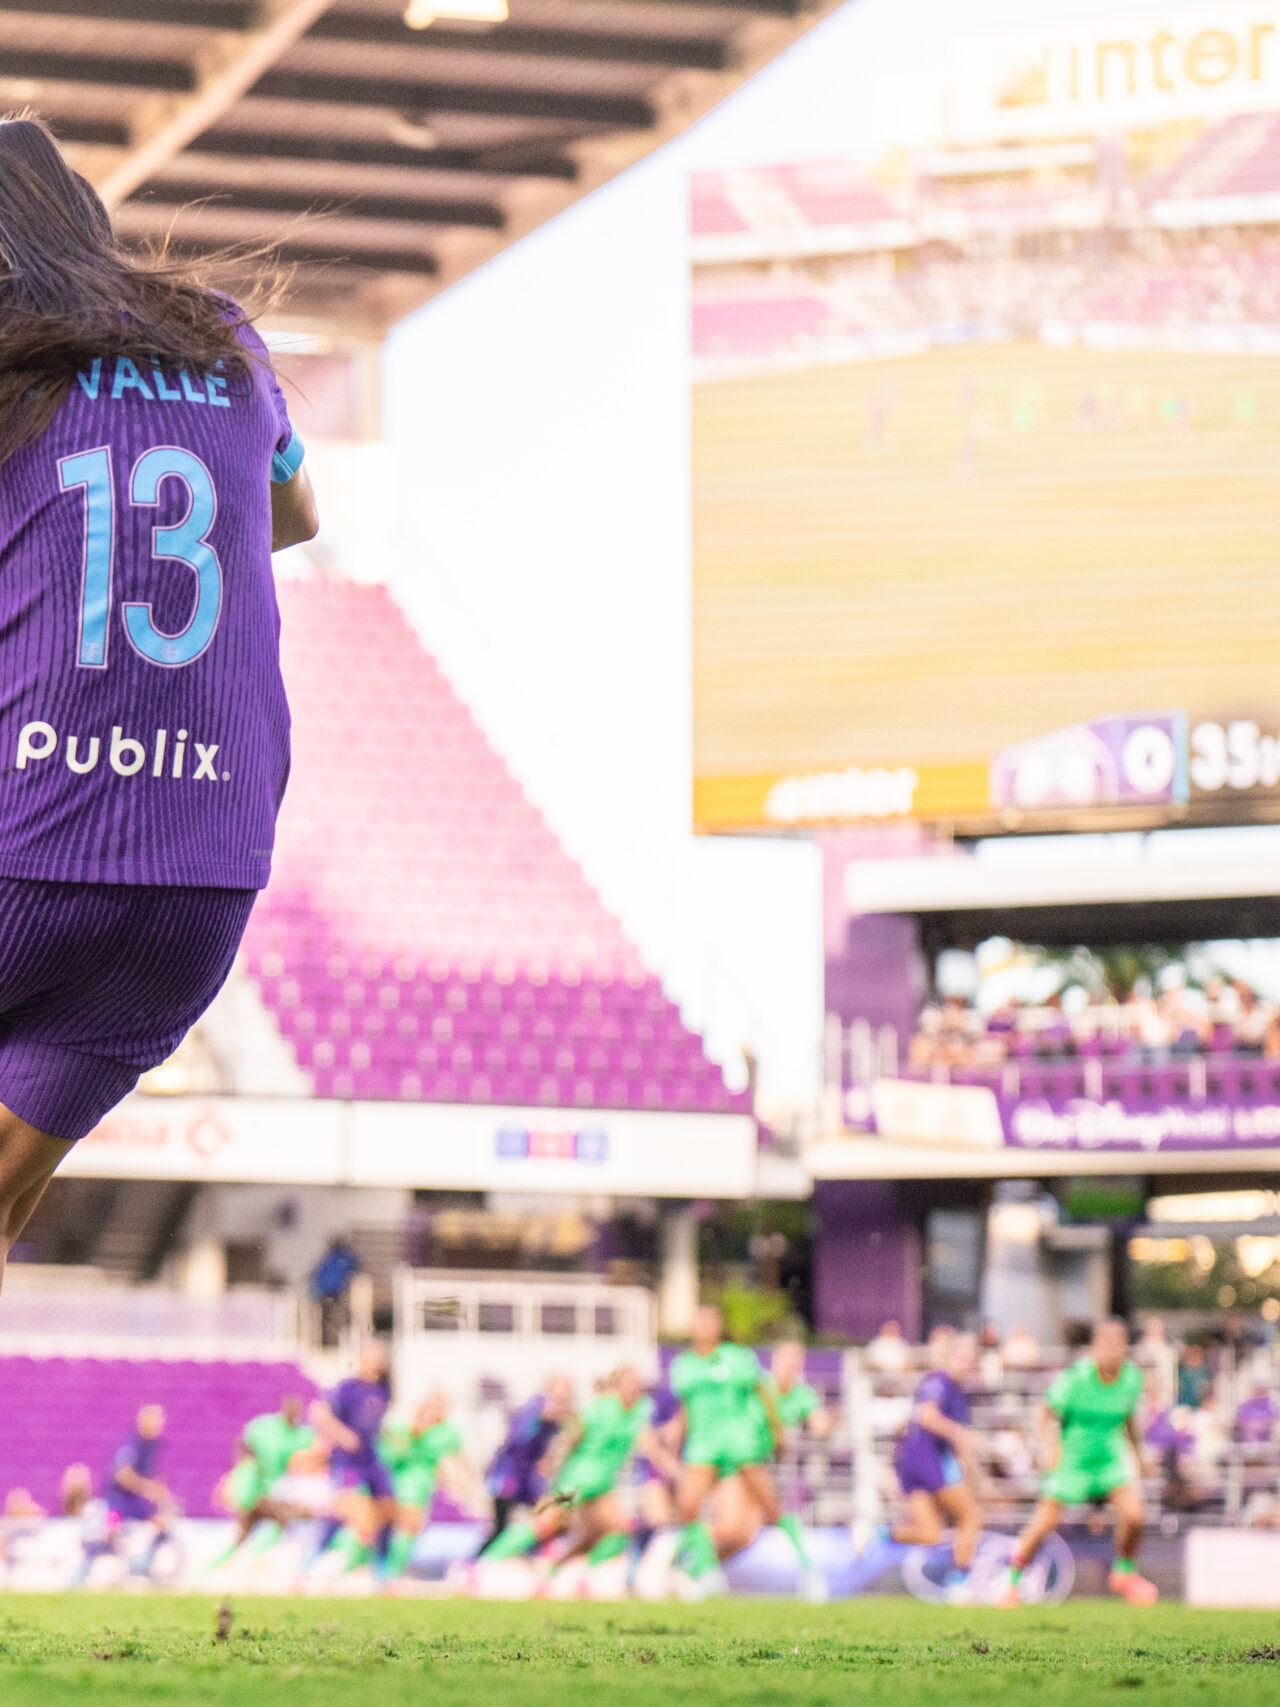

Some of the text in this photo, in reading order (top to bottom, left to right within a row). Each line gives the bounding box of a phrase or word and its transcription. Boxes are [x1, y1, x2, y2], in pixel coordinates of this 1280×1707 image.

[75, 352, 232, 408] VALLE
[56, 444, 224, 669] 13
[15, 720, 220, 781] Publix
